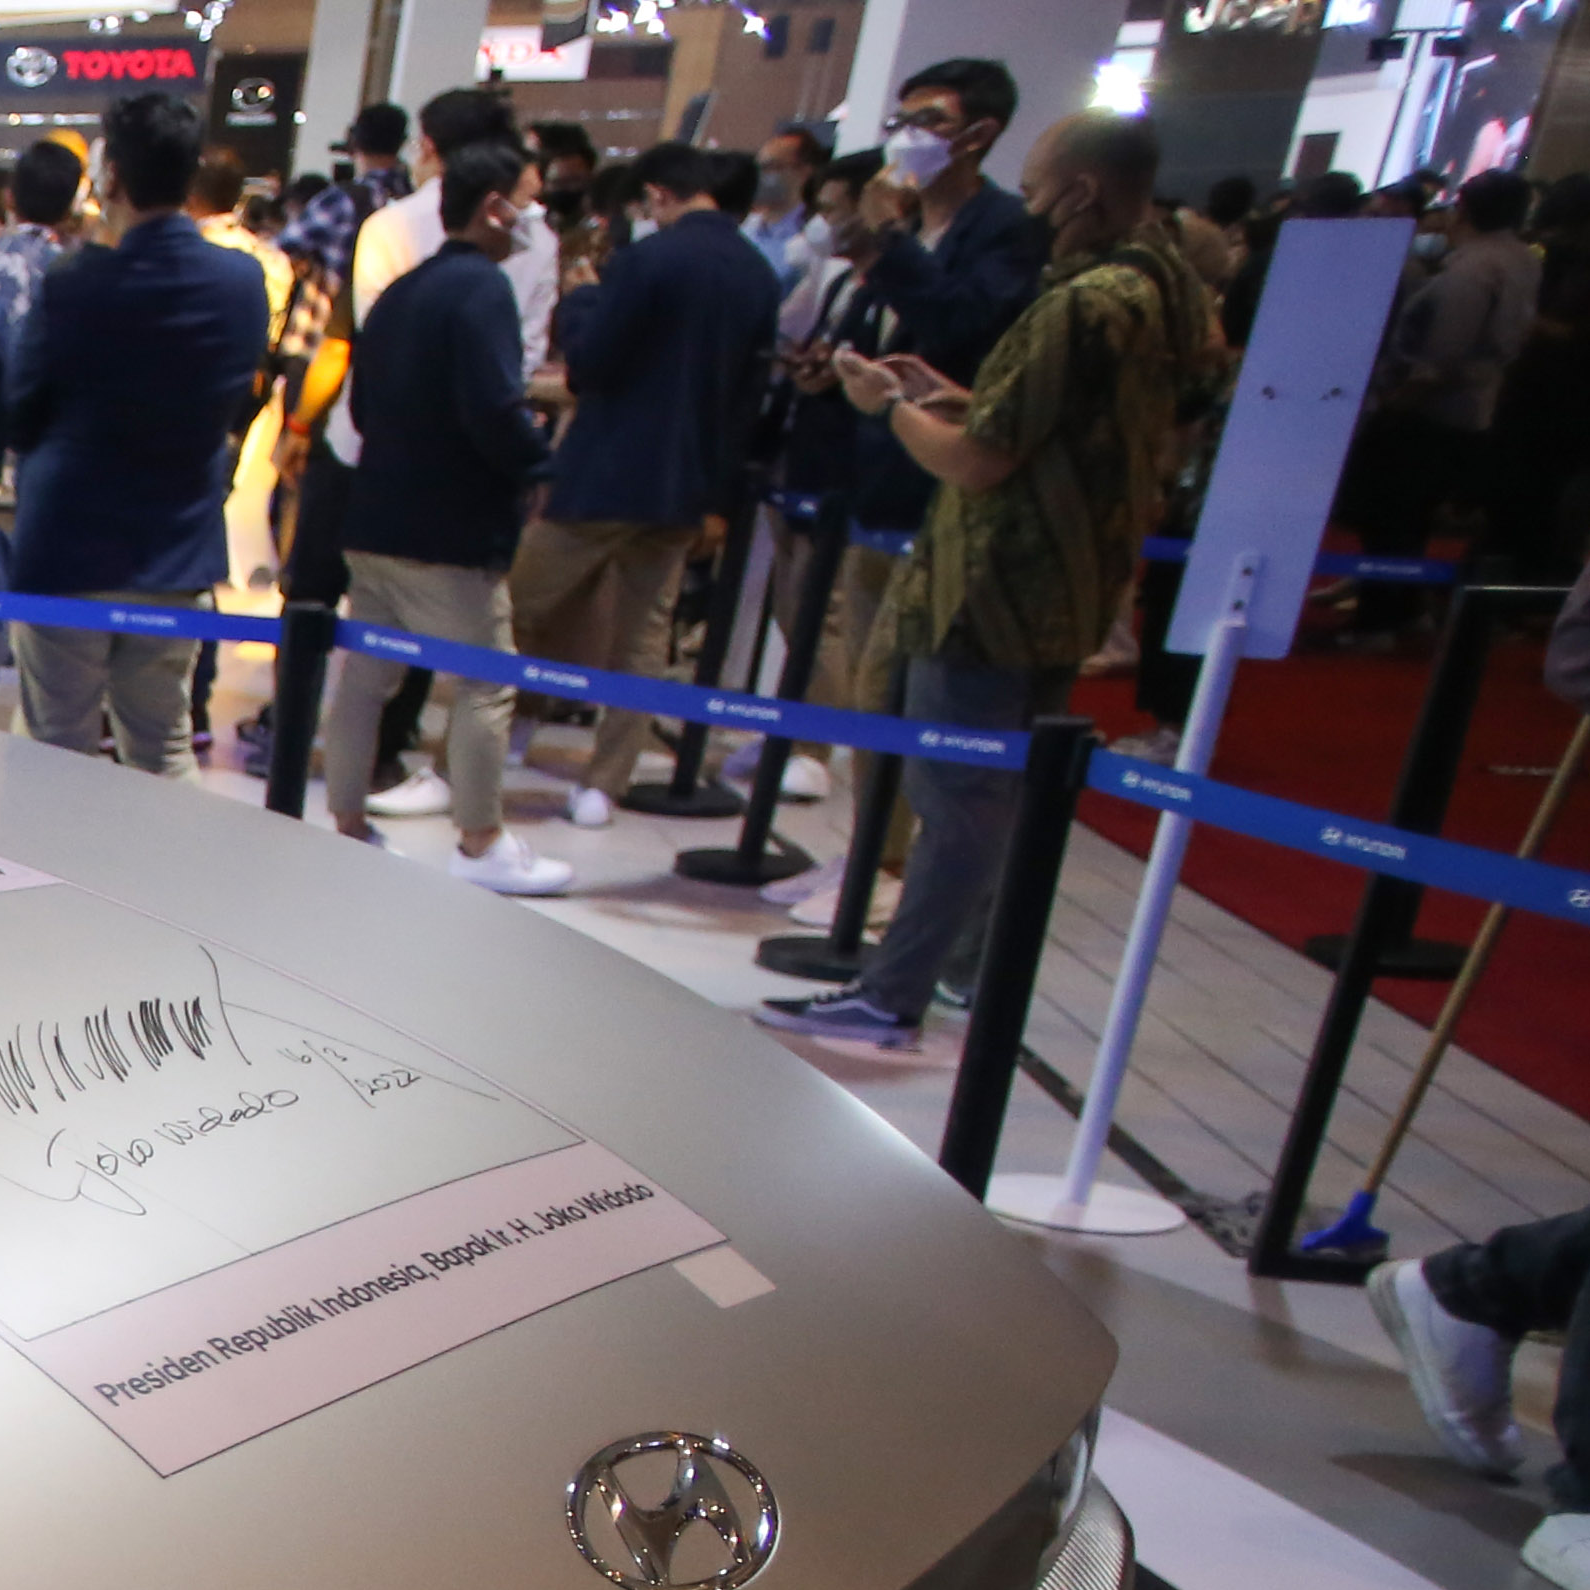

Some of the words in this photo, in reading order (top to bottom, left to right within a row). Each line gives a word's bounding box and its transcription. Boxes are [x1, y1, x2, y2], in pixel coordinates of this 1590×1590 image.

[62, 48, 196, 80] TOYOTA
[93, 1355, 220, 1408] Presiden
[207, 1304, 326, 1360] Republik
[310, 1263, 440, 1317] Indonesia,
[420, 1233, 501, 1273] Bapak
[507, 1217, 545, 1240] H.
[533, 1205, 588, 1231] Joko
[574, 1182, 655, 1216] Widodo
